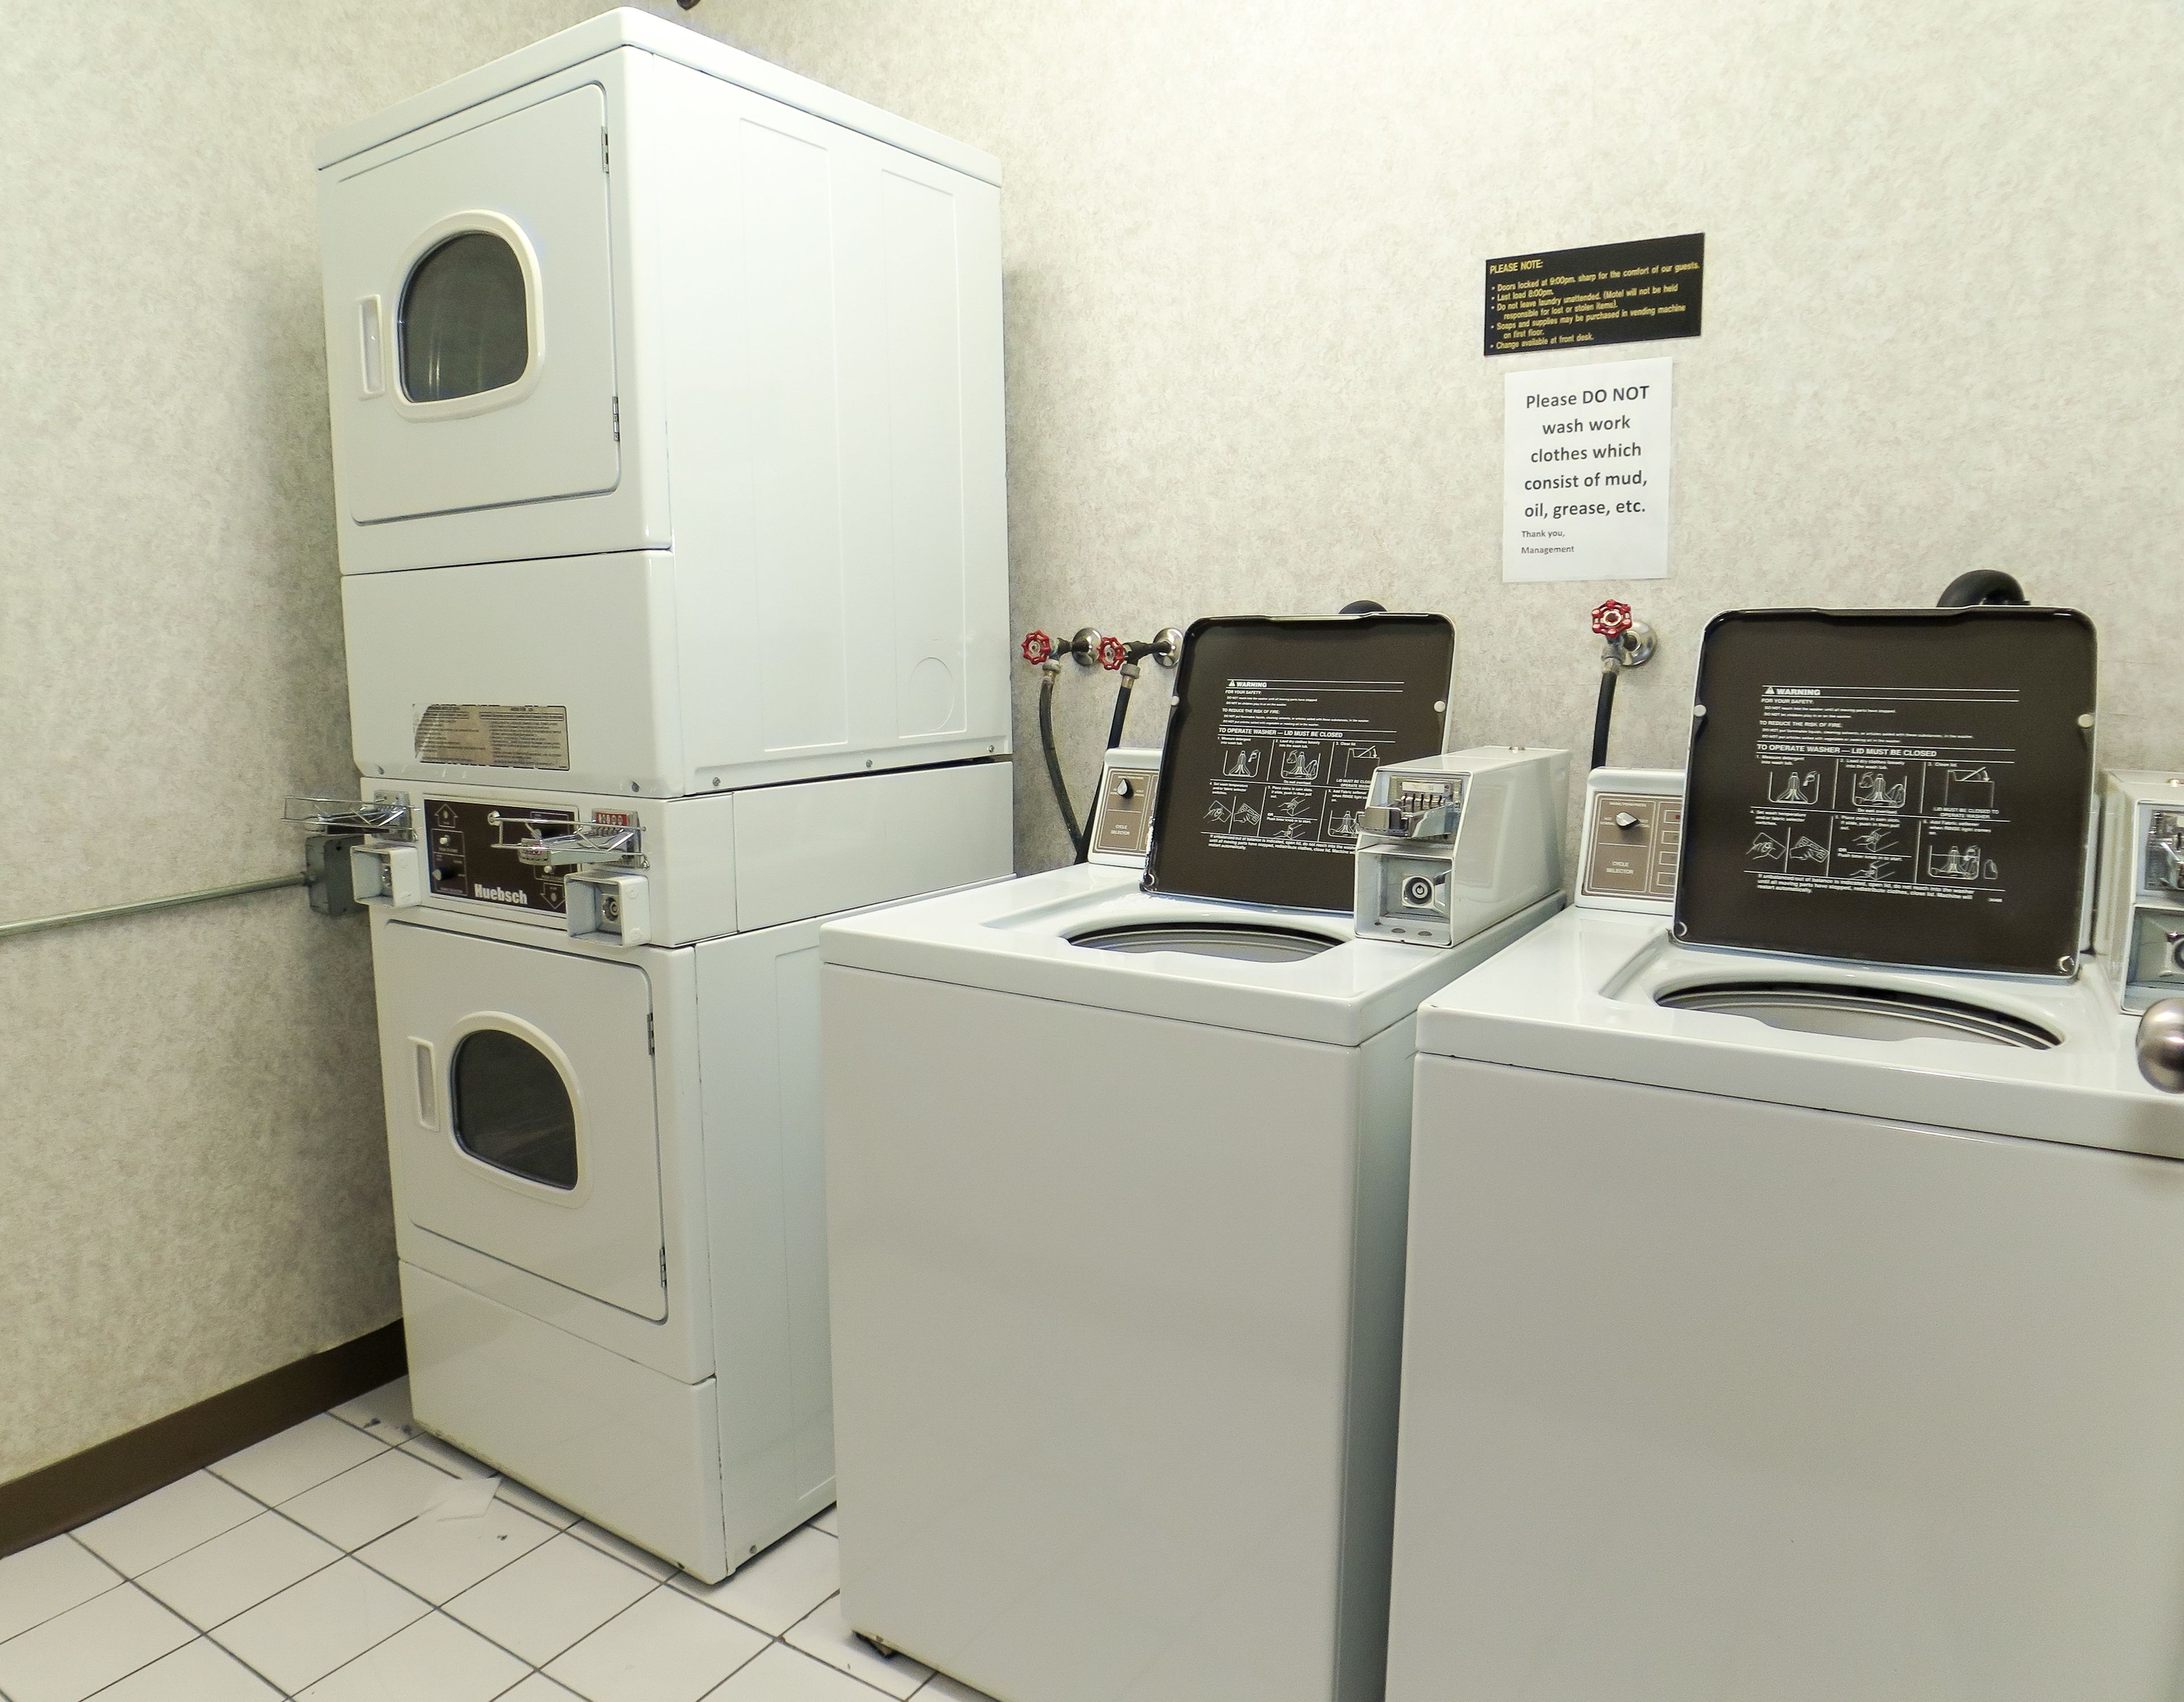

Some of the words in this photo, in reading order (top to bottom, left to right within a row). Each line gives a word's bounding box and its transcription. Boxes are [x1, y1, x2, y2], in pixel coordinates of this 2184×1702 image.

[1490, 261, 1518, 274] PLEASE
[1520, 258, 1543, 270] NOTE:
[1497, 282, 1516, 292] Doors
[1517, 279, 1539, 290] locked
[1549, 275, 1576, 286] 9:00pm.
[1578, 272, 1596, 283] sharp
[1598, 271, 1608, 280] for
[1610, 270, 1621, 279] the
[1622, 266, 1649, 278] comfort
[1651, 266, 1658, 274] of
[1674, 262, 1699, 274] guests.
[1496, 291, 1511, 301] Last
[1512, 290, 1526, 299] load
[1528, 286, 1554, 298] 8:00pm.
[1496, 302, 1506, 311] Do
[1507, 301, 1518, 310] not
[1520, 299, 1536, 309] leave
[1538, 296, 1561, 307] laundry
[1563, 292, 1601, 304] unattended.
[1603, 290, 1624, 302] (Motel
[1625, 288, 1637, 298] will
[1638, 287, 1650, 296] not
[1652, 286, 1661, 295] be
[1663, 283, 1678, 294] held
[1496, 320, 1516, 331] Soaps
[1517, 319, 1530, 328] and
[1532, 316, 1558, 328] supplies
[1559, 316, 1573, 325] may
[1575, 313, 1584, 322] be
[1585, 310, 1620, 323] purchased
[1621, 309, 1628, 317] in
[1629, 306, 1656, 317] vending
[1657, 303, 1686, 314] machine
[1503, 308, 1538, 320] responsible
[1540, 307, 1550, 316] for
[1551, 305, 1563, 315] lost
[1574, 302, 1594, 312] stolen
[1496, 339, 1519, 350] Change
[1521, 336, 1548, 346] available
[1558, 333, 1574, 343] front
[1576, 331, 1594, 341] desk.
[1513, 329, 1526, 338] first
[1528, 327, 1544, 337] floor.
[1527, 391, 1577, 408] Please
[1582, 389, 1607, 404] DO
[1613, 386, 1650, 402] NOT
[1542, 419, 1583, 434] wash
[1589, 415, 1630, 431] work
[1531, 446, 1587, 462] clothes
[1592, 443, 1641, 459] which
[1524, 475, 1578, 490] consist
[1583, 473, 1600, 487] of
[1605, 470, 1647, 488] mud,
[1524, 503, 1548, 519] oil,
[1553, 504, 1610, 519] grease,
[1616, 501, 1645, 514] etc.
[1521, 529, 1545, 538] Thank
[1521, 546, 1574, 555] Management
[474, 883, 528, 904] Huebsch
